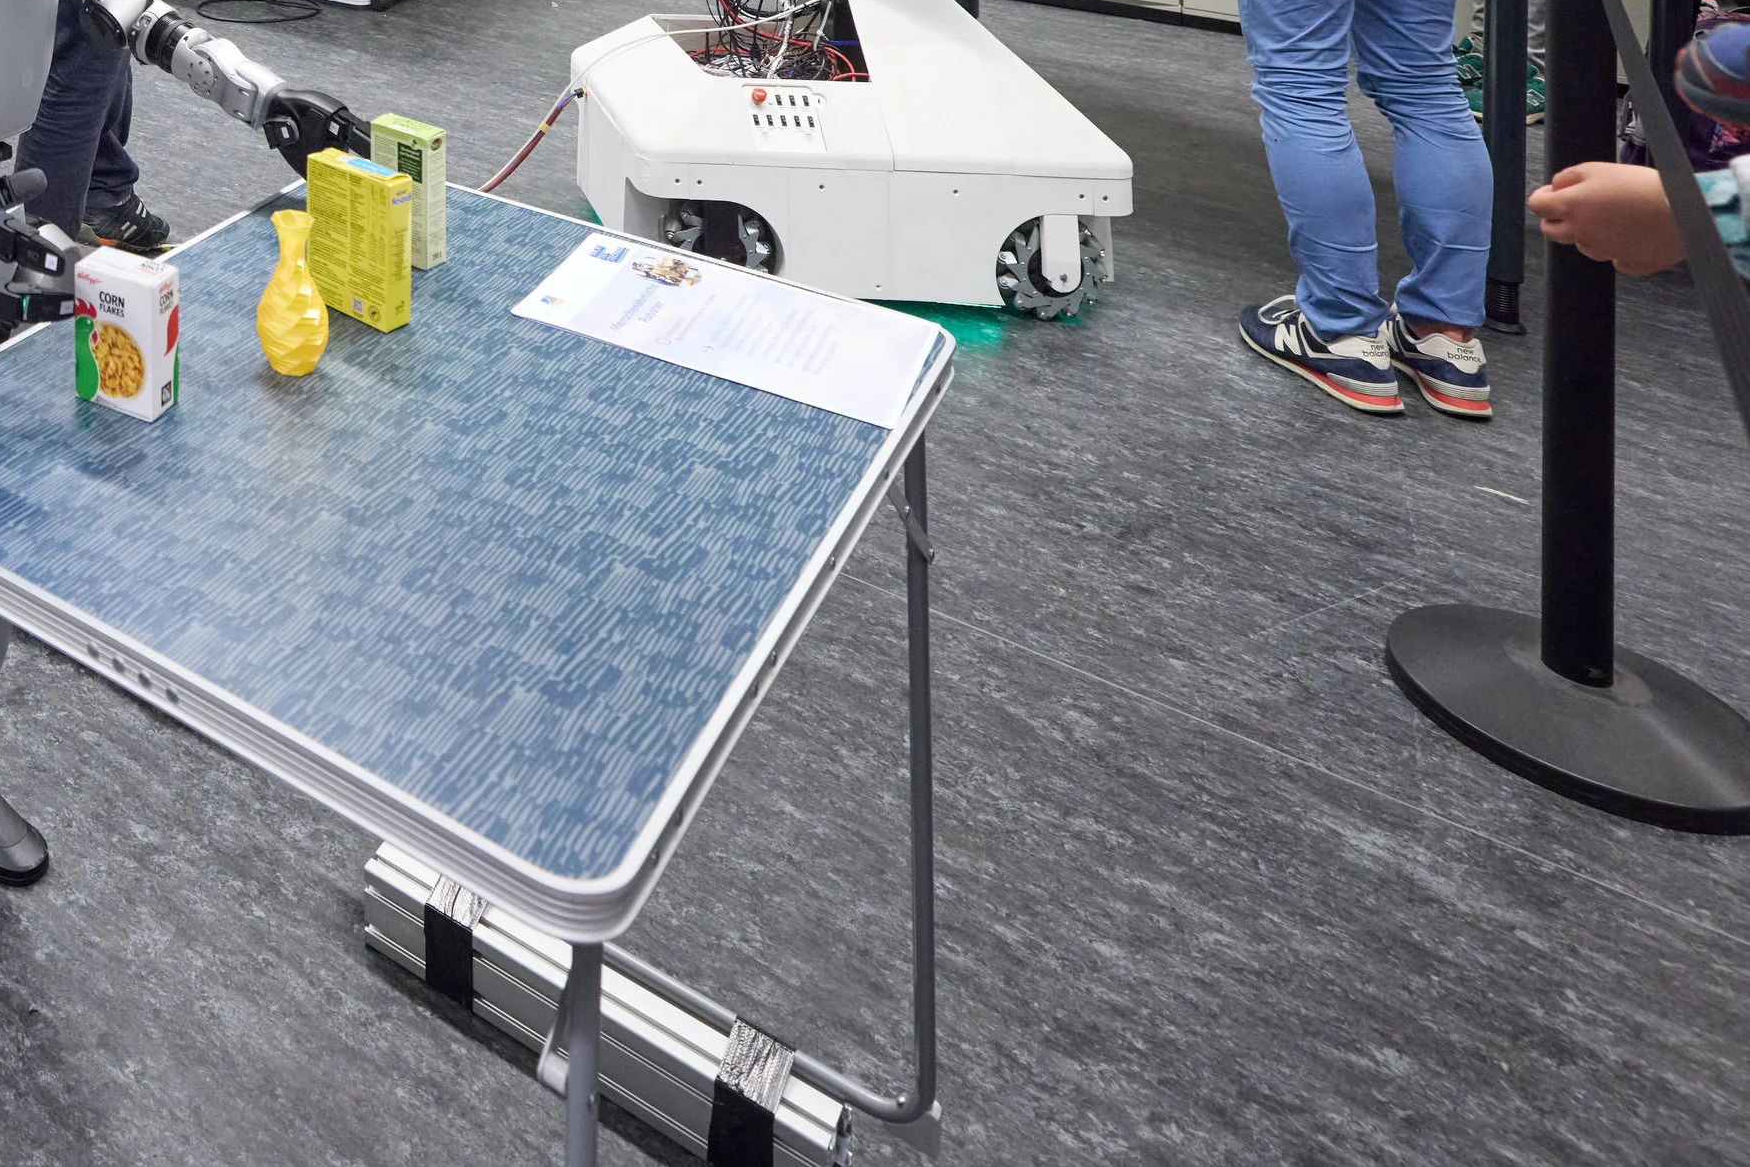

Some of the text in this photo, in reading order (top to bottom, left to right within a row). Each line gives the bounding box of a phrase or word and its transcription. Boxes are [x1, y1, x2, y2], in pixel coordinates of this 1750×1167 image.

[99, 290, 125, 309] CORN
[159, 290, 174, 307] CORN
[99, 303, 125, 318] FLAKES
[1362, 349, 1390, 358] balanc
[1370, 344, 1385, 352] new
[1456, 347, 1475, 356] new
[1446, 350, 1482, 364] balance
